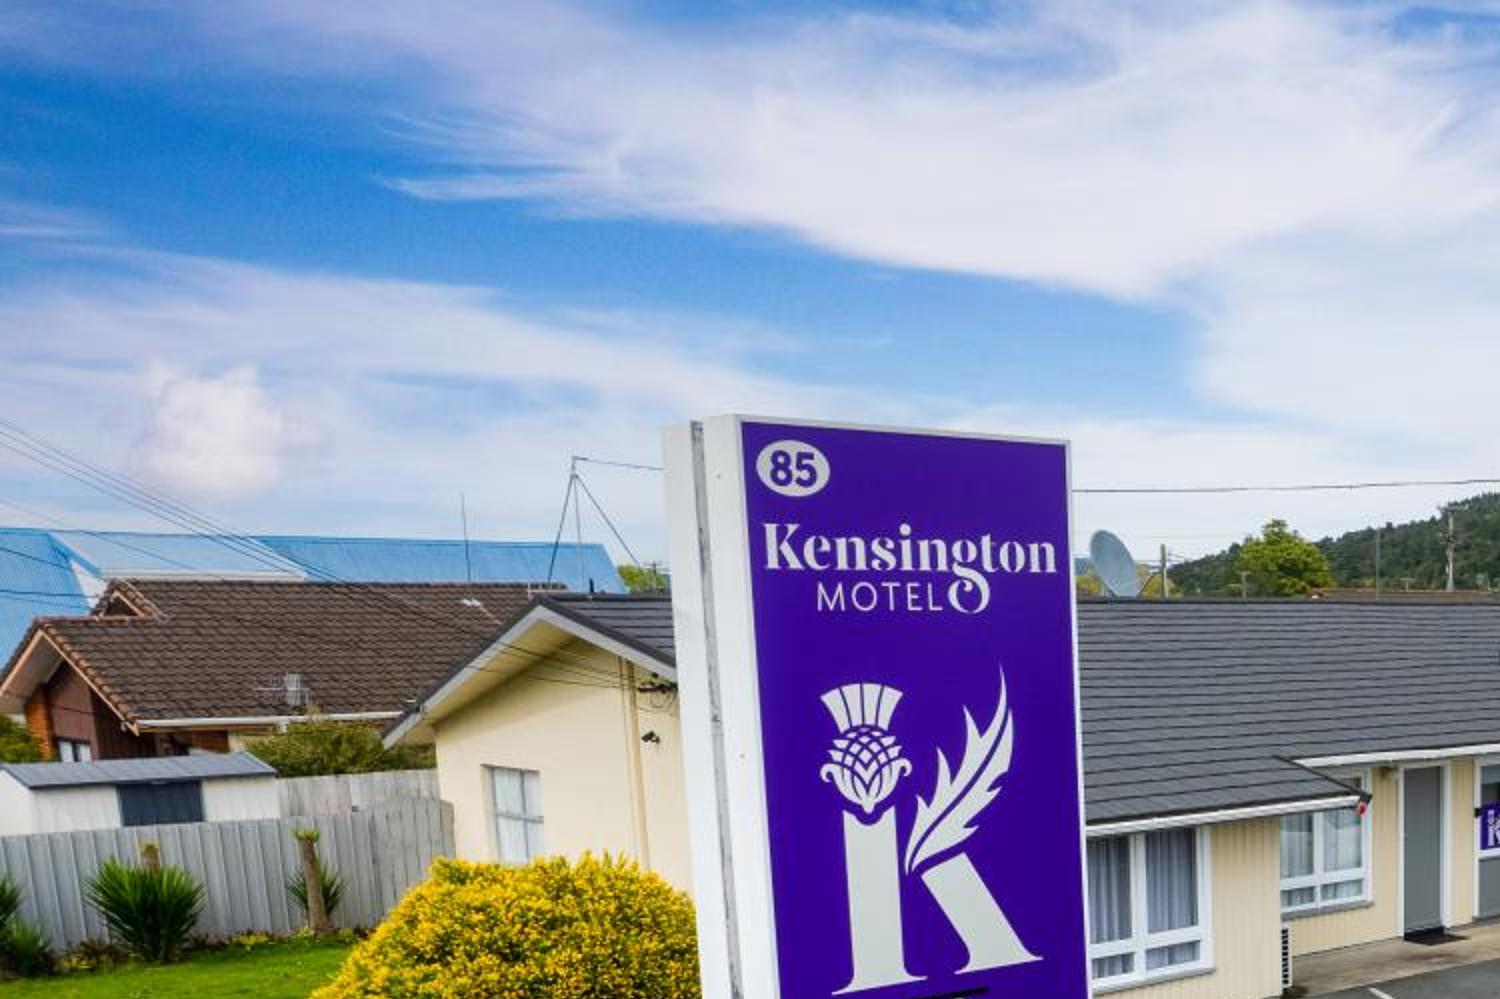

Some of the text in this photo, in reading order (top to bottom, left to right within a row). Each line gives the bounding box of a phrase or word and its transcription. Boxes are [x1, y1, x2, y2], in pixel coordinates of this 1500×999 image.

[769, 449, 818, 488] 85
[763, 523, 1058, 615] Kensington
[817, 581, 943, 612] MOTEL
